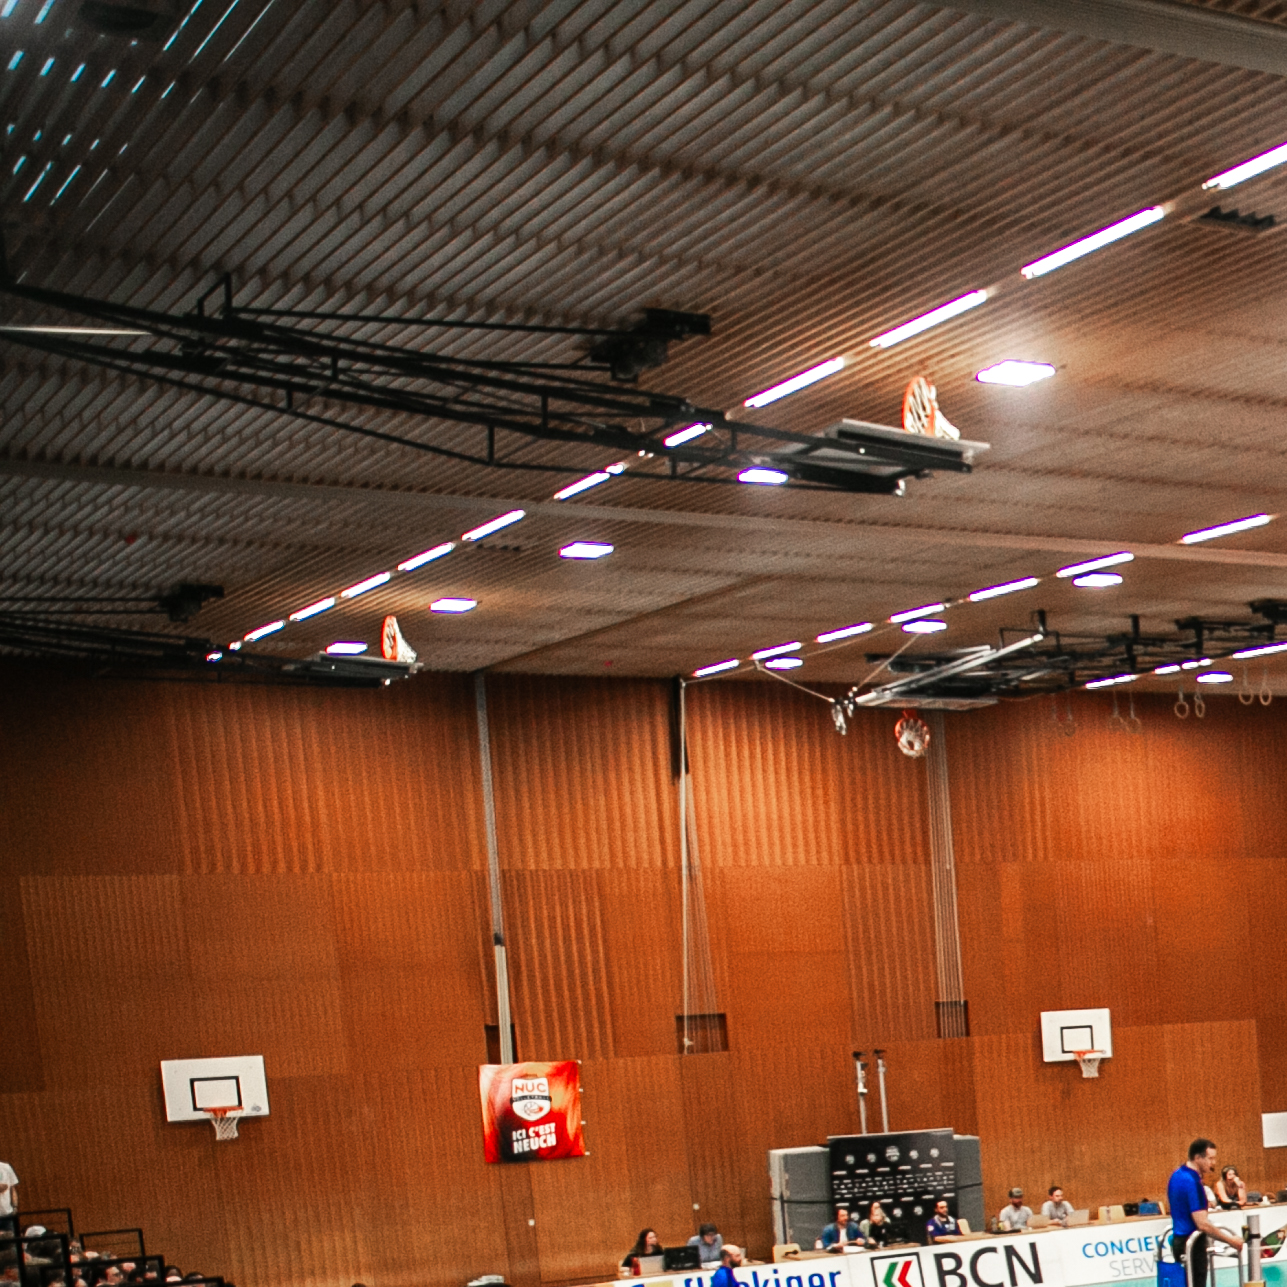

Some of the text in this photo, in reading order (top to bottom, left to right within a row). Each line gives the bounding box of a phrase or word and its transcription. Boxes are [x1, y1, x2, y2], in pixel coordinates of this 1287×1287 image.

[514, 1083, 547, 1094] NUC
[512, 1123, 556, 1141] ICI C'EST
[513, 1133, 557, 1154] NEUCH
[1082, 1235, 1173, 1258] CONCIE
